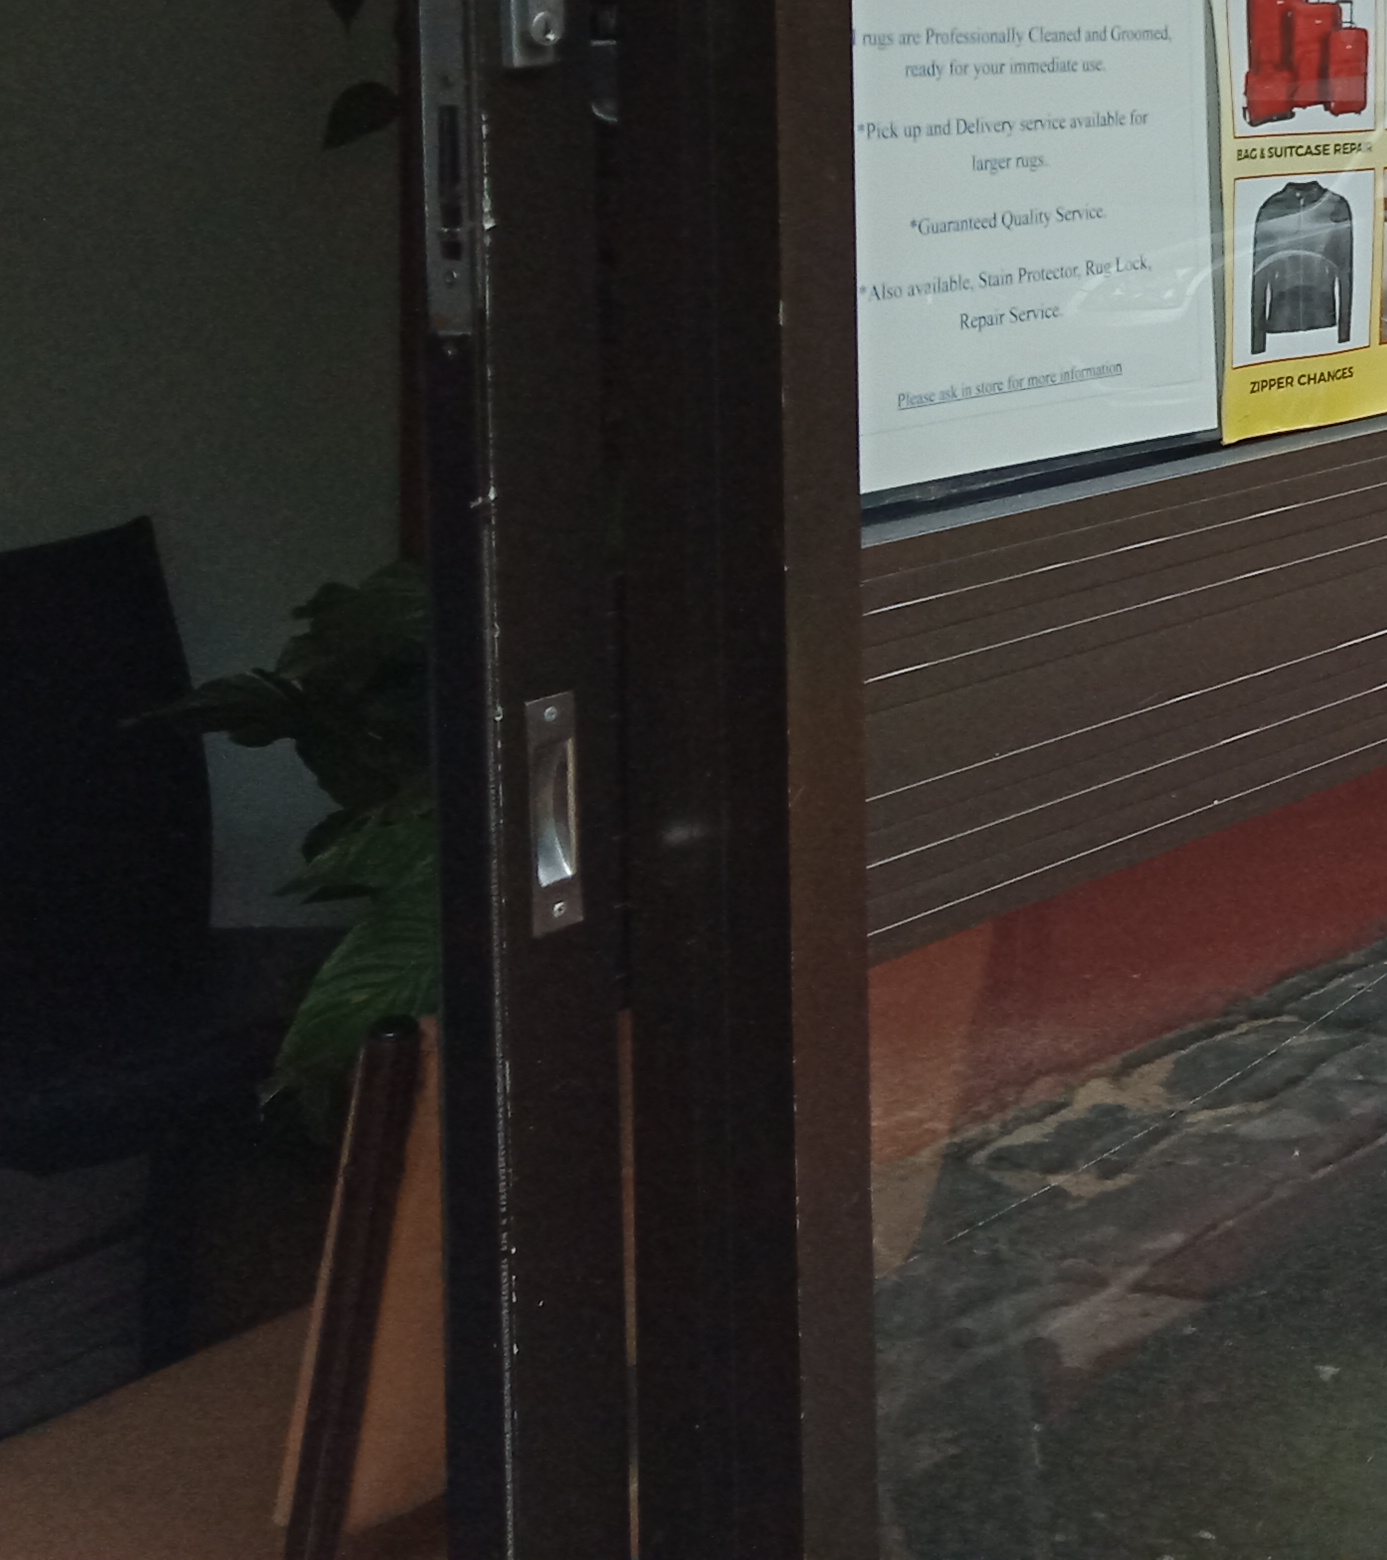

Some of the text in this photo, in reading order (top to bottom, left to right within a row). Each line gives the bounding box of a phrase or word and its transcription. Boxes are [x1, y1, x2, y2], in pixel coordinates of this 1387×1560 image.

[862, 32, 894, 51] rugs
[899, 33, 921, 46] are
[925, 26, 1024, 48] Professionally
[1028, 25, 1081, 43] Cleaned
[1085, 25, 1107, 42] and
[1110, 24, 1173, 43] Groomed,
[905, 59, 942, 81] ready
[949, 59, 970, 77] for
[973, 61, 1006, 84] your
[1010, 57, 1078, 75] immediate
[904, 124, 921, 141] up
[926, 118, 951, 137] and
[956, 116, 1014, 139] Delivery
[1019, 114, 1066, 133] service
[1070, 110, 1126, 129] available
[1129, 108, 1149, 126] for
[972, 153, 1012, 175] larger
[1237, 147, 1258, 162] BAG
[1259, 146, 1266, 159] &
[1267, 141, 1331, 159] SUITCASE
[1001, 207, 1051, 230] Quality
[1055, 203, 1106, 222] Service.
[907, 274, 974, 297] available,
[978, 270, 1013, 289] Stain
[1018, 264, 1082, 284] Protector,
[1085, 258, 1111, 277] Rug
[1115, 254, 1152, 273] Lock,
[960, 312, 1005, 333] Repair
[897, 362, 1123, 409] Please ask in store for more information
[1249, 366, 1354, 394] ZIPPER CHANGES
